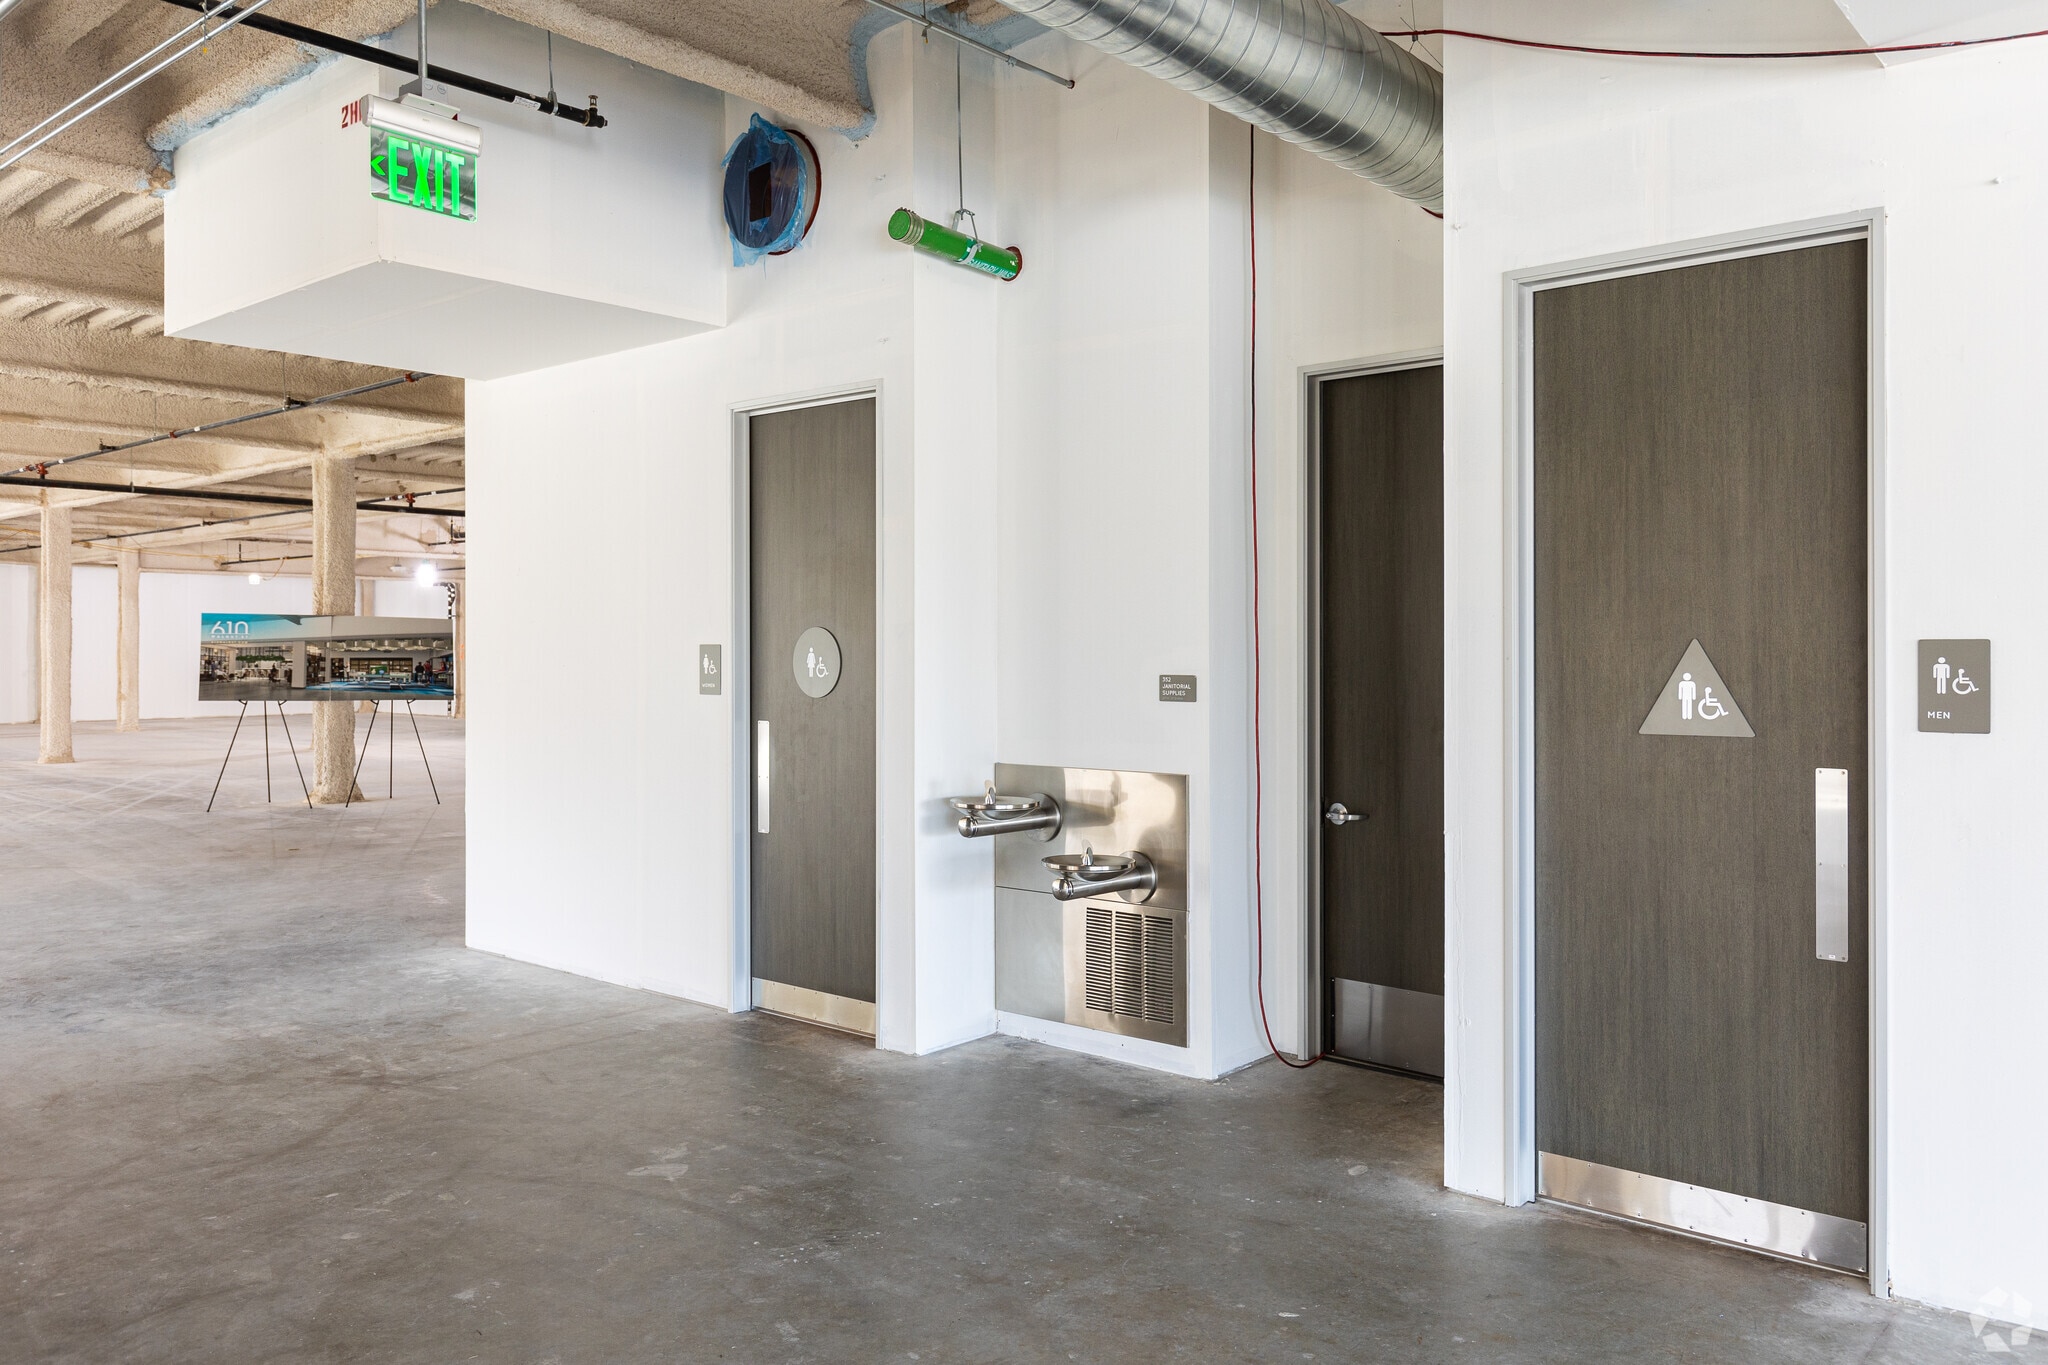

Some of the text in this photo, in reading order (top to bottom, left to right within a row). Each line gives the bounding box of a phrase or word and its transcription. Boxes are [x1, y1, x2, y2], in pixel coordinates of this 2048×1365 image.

[388, 136, 465, 216] EXIT
[211, 620, 249, 634] 610
[1927, 711, 1951, 719] MEN
